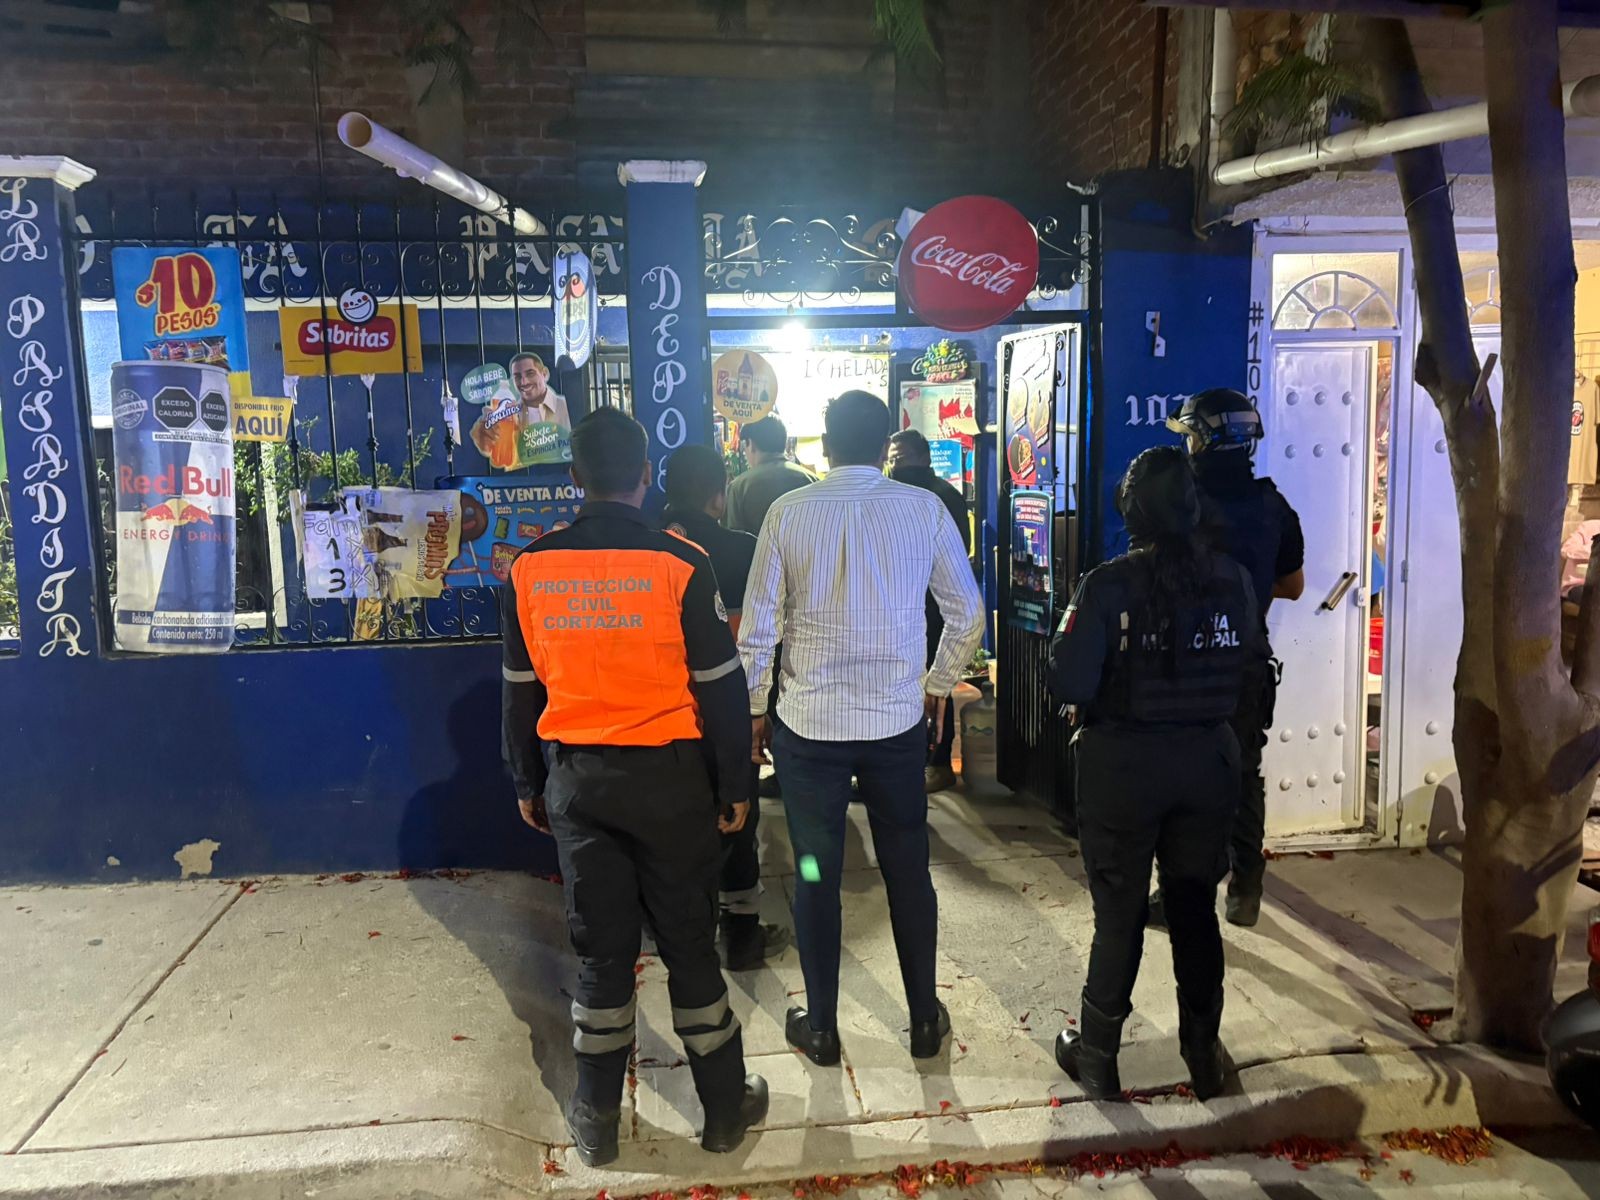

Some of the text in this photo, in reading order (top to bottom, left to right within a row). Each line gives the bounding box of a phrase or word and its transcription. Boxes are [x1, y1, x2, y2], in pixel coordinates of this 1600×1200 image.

[911, 235, 1029, 296] Coca-Cola
[137, 253, 215, 315] $10
[305, 321, 390, 349] Sabritas
[161, 399, 190, 408] EXCESO
[235, 412, 283, 437] AQUÍ
[530, 433, 559, 448] Sabor
[119, 463, 232, 498] Red Bull
[503, 487, 551, 503] VENTA
[554, 485, 586, 500] AQU
[328, 568, 347, 593] 3
[532, 575, 653, 595] PROTECCIÓN
[567, 597, 617, 612] CIVIL
[153, 612, 195, 625] carbonatada
[543, 613, 644, 631] CORTAZAR
[151, 627, 186, 640] Contenido
[204, 628, 217, 640] 250
